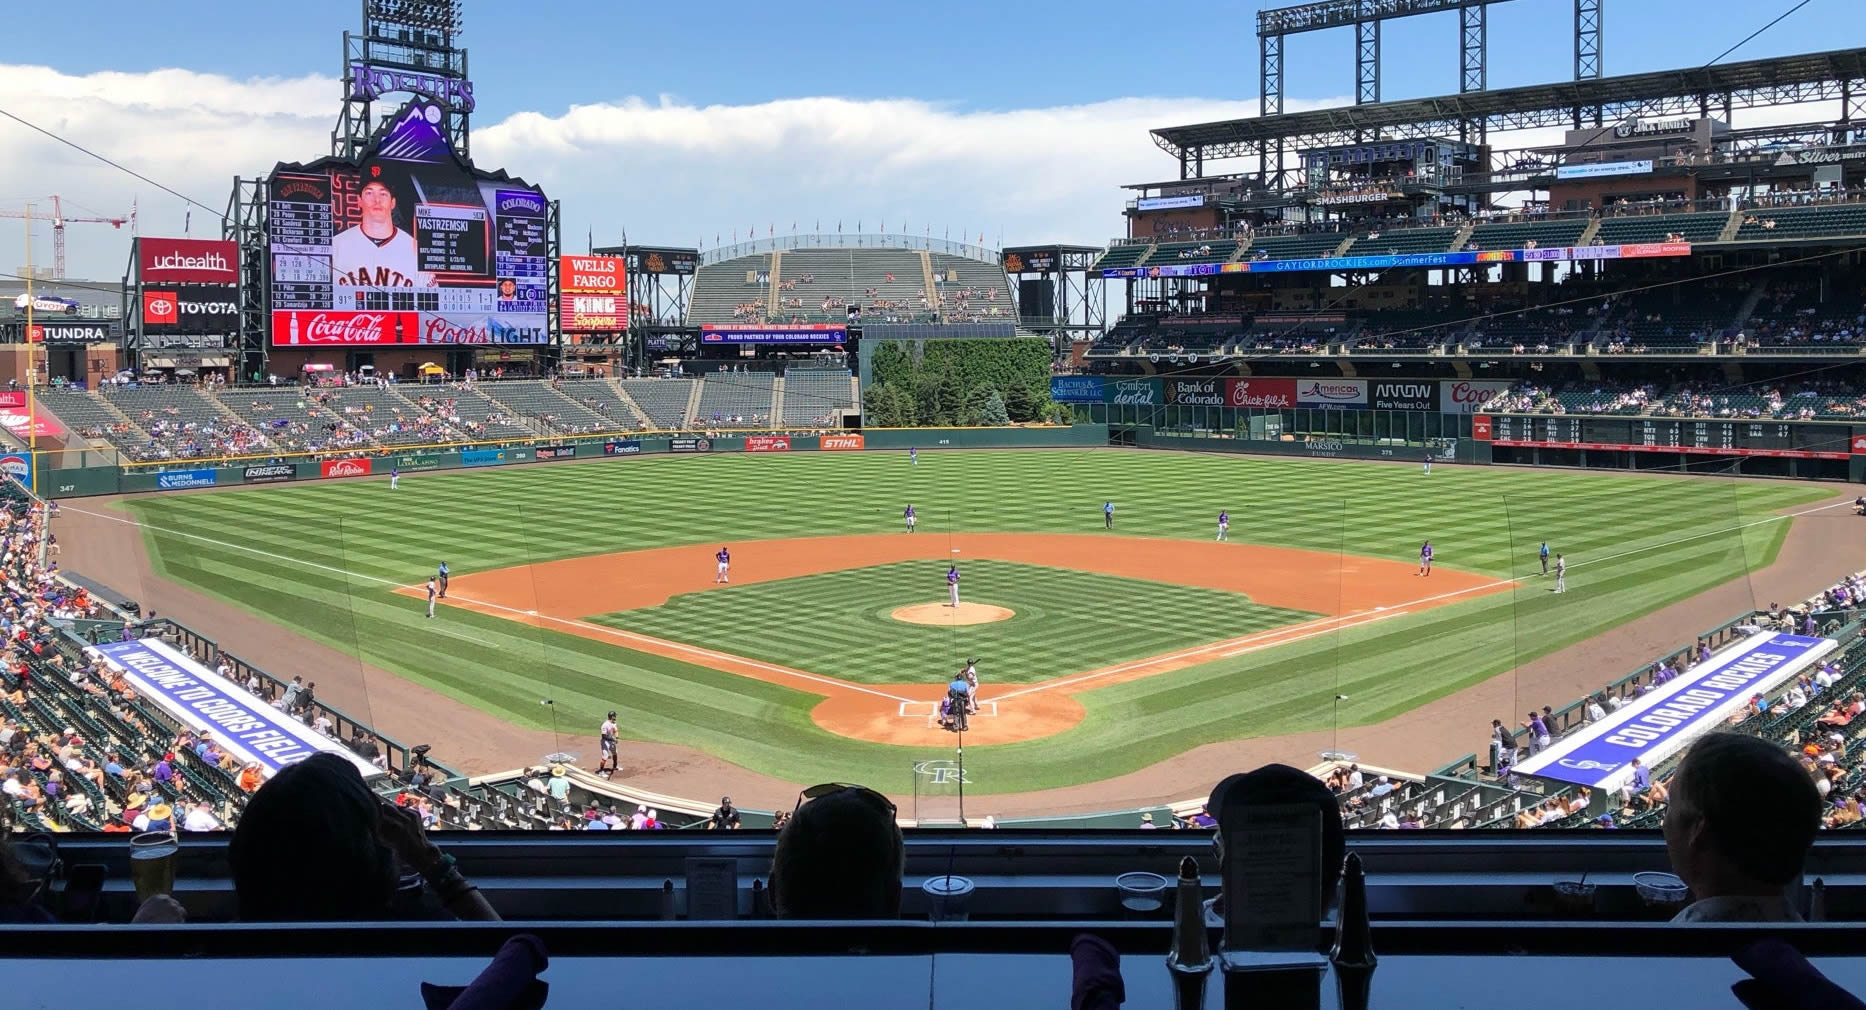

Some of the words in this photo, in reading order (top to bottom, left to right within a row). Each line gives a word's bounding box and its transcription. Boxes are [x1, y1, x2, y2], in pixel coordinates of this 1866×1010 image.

[351, 66, 476, 113] ROCKIES
[1634, 120, 1656, 133] JACK
[1799, 151, 1841, 164] Silver
[501, 197, 541, 213] COLORADO
[1316, 193, 1388, 206] SMASHBURGER
[418, 208, 432, 216] MIKE
[417, 218, 469, 232] YASTRZEMSKI
[154, 251, 227, 269] uchealth
[573, 259, 615, 273] WELLS
[1276, 255, 1447, 270] GAYLORDROCKIES.com/SummerFest
[573, 275, 616, 288] FARGO
[178, 302, 238, 315] TOYOTA
[574, 297, 615, 314] KING
[574, 313, 617, 328] Soopers
[43, 327, 104, 339] TUNDRA
[307, 313, 385, 342] Coca-Cola
[426, 317, 488, 344] Coors
[491, 326, 542, 343] LIGHT
[1116, 380, 1151, 391] Comfort
[1177, 381, 1202, 393] Bank
[1204, 381, 1215, 393] of
[1313, 382, 1359, 394] American
[1114, 389, 1154, 405] dental
[1177, 393, 1224, 405] Colorado
[1233, 384, 1289, 408] Chick-fil-A
[1452, 382, 1497, 403] Coo
[1377, 401, 1393, 409] Five
[1393, 401, 1415, 409] Years
[1415, 402, 1431, 410] Out
[1462, 403, 1480, 412] LIG
[749, 437, 773, 445] brakes
[823, 439, 860, 448] STIHL
[1305, 441, 1342, 451] MARSICO
[329, 466, 344, 477] Red
[343, 466, 365, 475] Robin
[59, 485, 75, 493] 347
[120, 651, 192, 690] WELCOME
[174, 685, 216, 700] TO
[1605, 688, 1725, 748] COLORADO
[1702, 652, 1786, 691] ROCKIES
[192, 698, 265, 734] COORS
